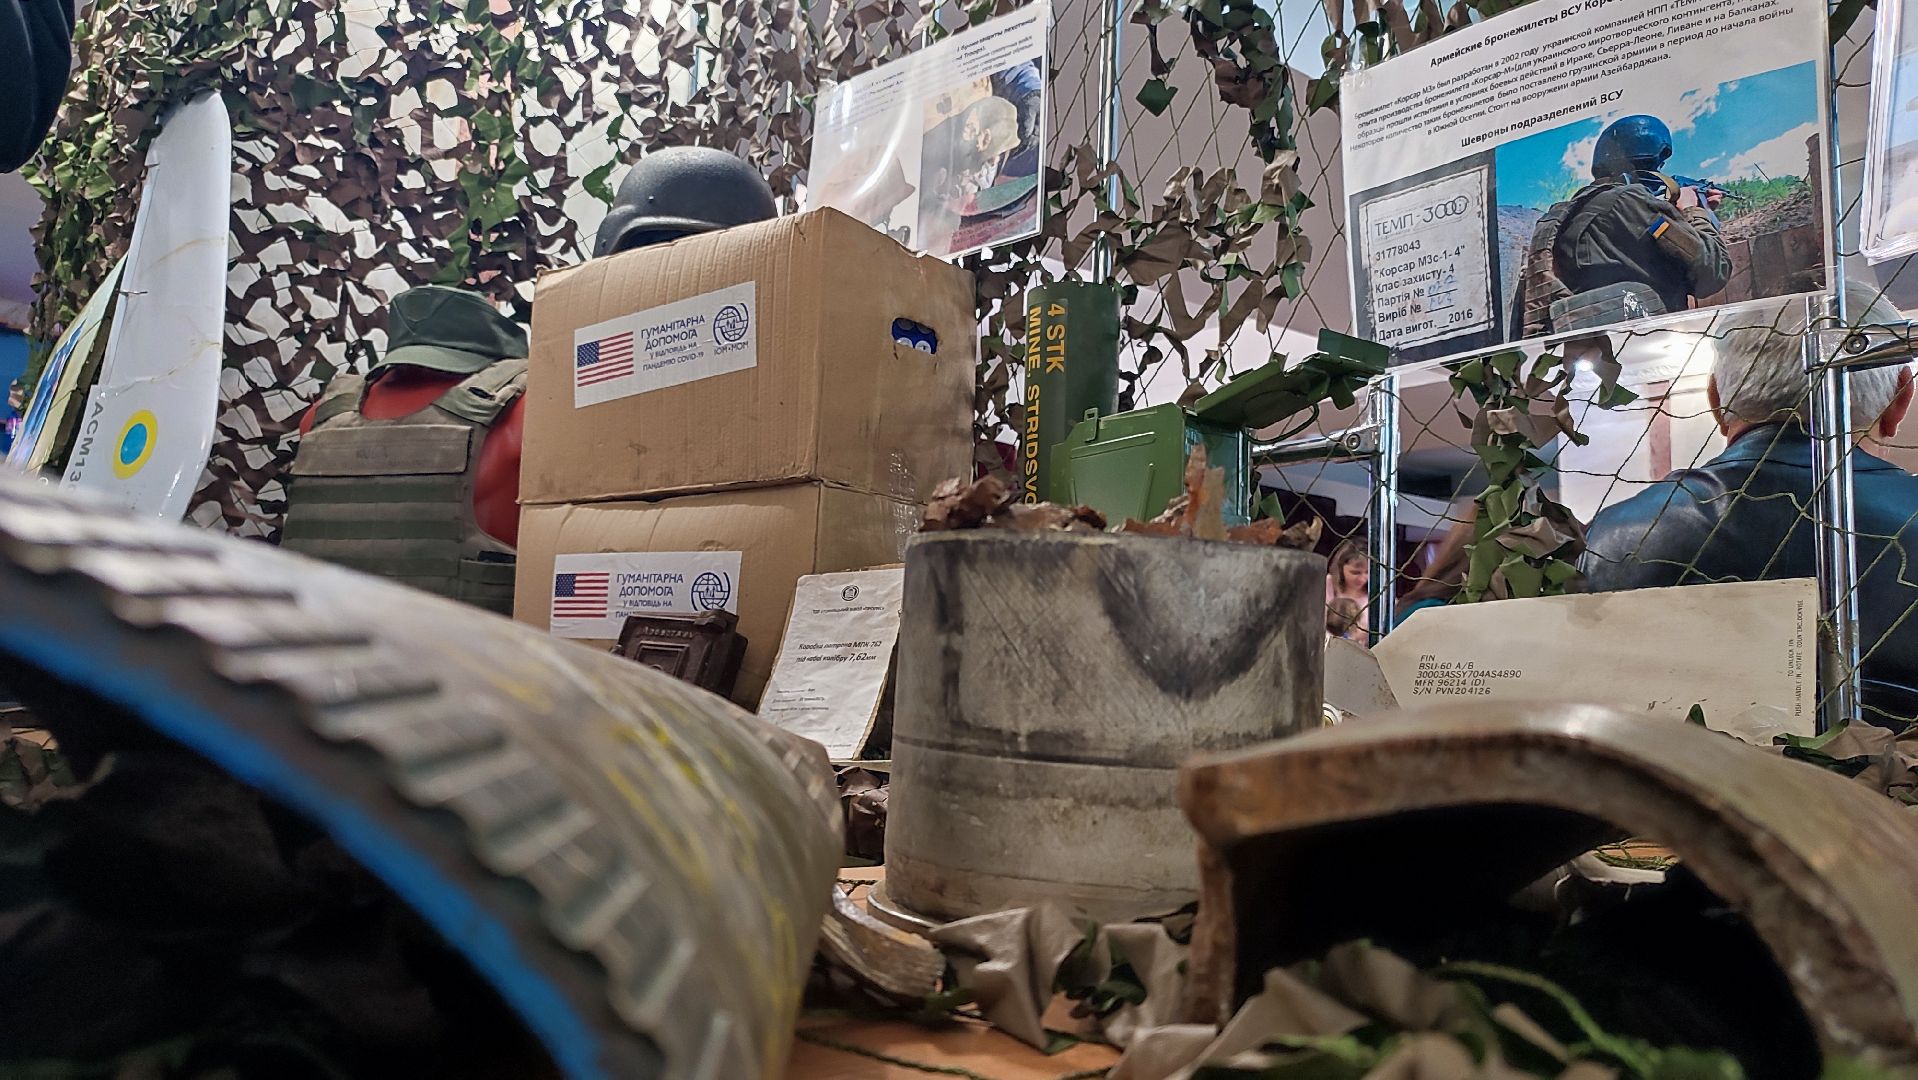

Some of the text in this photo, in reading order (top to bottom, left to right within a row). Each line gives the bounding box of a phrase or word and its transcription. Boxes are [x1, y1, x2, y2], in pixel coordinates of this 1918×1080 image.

[1430, 41, 1482, 68] Армейские
[1484, 13, 1558, 46] бронежилеты
[1560, 2, 1582, 19] ВСУ
[1436, 79, 1451, 89] был
[1451, 62, 1493, 85] разработан
[1500, 51, 1520, 65] 2002
[1520, 46, 1540, 58] году
[1542, 27, 1592, 53] украинской
[1594, 10, 1645, 34] компанией
[1646, 3, 1668, 17] НПП
[1378, 100, 1423, 122] производства
[1424, 82, 1470, 105] бронежилета
[1532, 42, 1586, 67] украинского
[1587, 17, 1670, 47] миротворческого
[1385, 115, 1412, 129] прошли
[1455, 86, 1488, 106] условиях
[1489, 76, 1518, 91] боевых
[1519, 61, 1558, 82] действий
[1566, 51, 1595, 65] Ираке,
[1596, 31, 1665, 55] Сьерра-Леоне,
[1666, 19, 1703, 35] Ливане
[1713, 13, 1726, 22] на
[1423, 115, 1441, 126] таких
[1442, 95, 1495, 119] бронежилетов
[1497, 87, 1518, 99] было
[1519, 71, 1568, 92] поставлено
[1568, 54, 1619, 77] грузинской
[1667, 31, 1704, 47] период
[1705, 27, 1719, 38] до
[1720, 17, 1756, 32] начала
[1758, 7, 1793, 22] войны
[1510, 97, 1521, 106] на
[1570, 72, 1599, 87] армии
[1600, 53, 1671, 78] Азейбарджана.
[1461, 88, 1624, 148] Шевроны подразделений ВСУ
[1375, 239, 1421, 261] 31778043
[1375, 280, 1400, 294] Клас
[1448, 263, 1455, 274] 4
[1377, 287, 1425, 309] Партія №
[1378, 304, 1422, 323] Виріб №
[641, 315, 706, 339] ГУМАНІТАРНА
[645, 329, 698, 352] ДОПОМОГА
[1045, 303, 1067, 374] 4 STK
[1378, 327, 1404, 343] Дата
[1448, 308, 1474, 324] 2016
[1026, 306, 1042, 378] MINE,
[68, 402, 104, 488] ACM13
[616, 573, 684, 585] ГУМАНІТАРНА
[619, 586, 674, 597] ДОПОМОГА
[1420, 654, 1436, 662] FIN
[1454, 661, 1474, 670] A/B
[1412, 687, 1432, 696] S/N
[1414, 678, 1486, 687] MFR 96214 (D)
